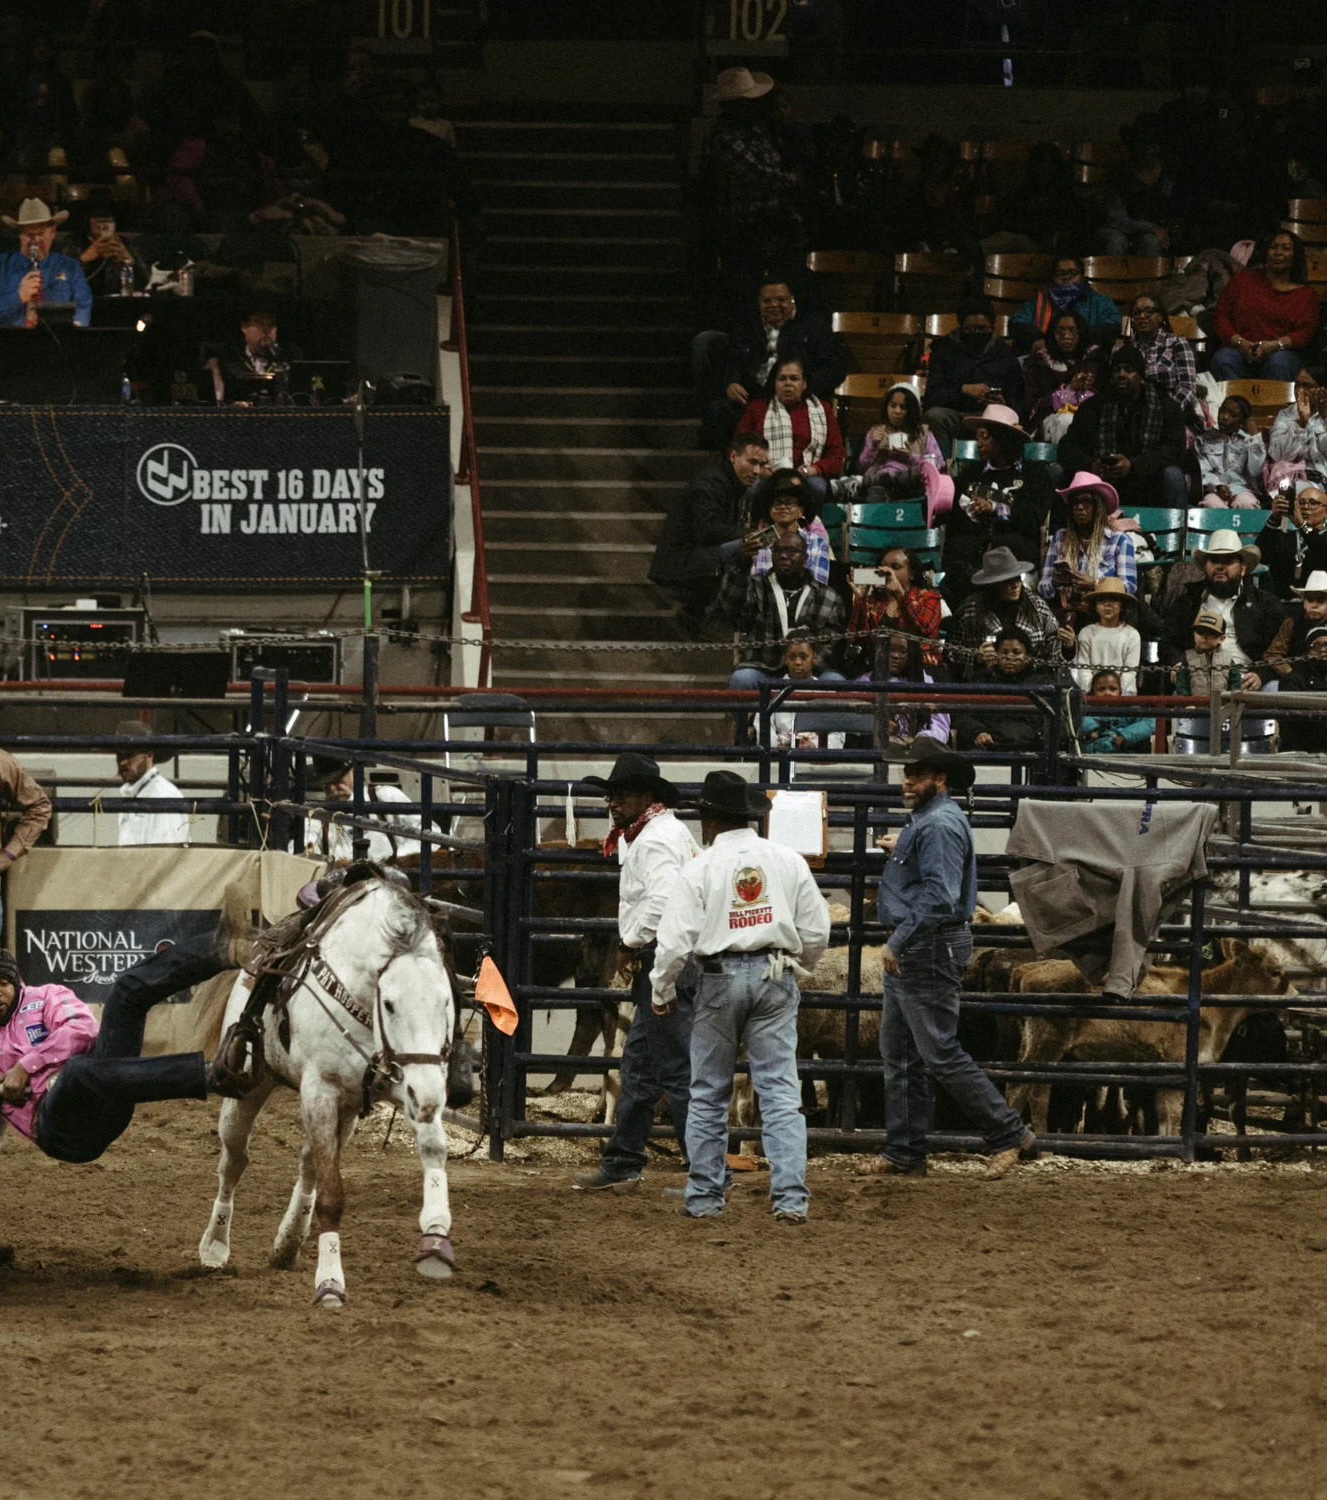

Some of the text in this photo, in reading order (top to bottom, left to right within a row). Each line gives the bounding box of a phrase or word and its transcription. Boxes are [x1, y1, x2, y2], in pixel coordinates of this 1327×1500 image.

[192, 468, 385, 500] BEST 16 DAYS
[200, 503, 376, 534] IN JANUARY
[895, 508, 905, 521] 2
[1231, 514, 1241, 527] 5
[729, 912, 773, 929] RODEO
[24, 928, 143, 953] NATIONAL
[317, 966, 336, 991] PAT
